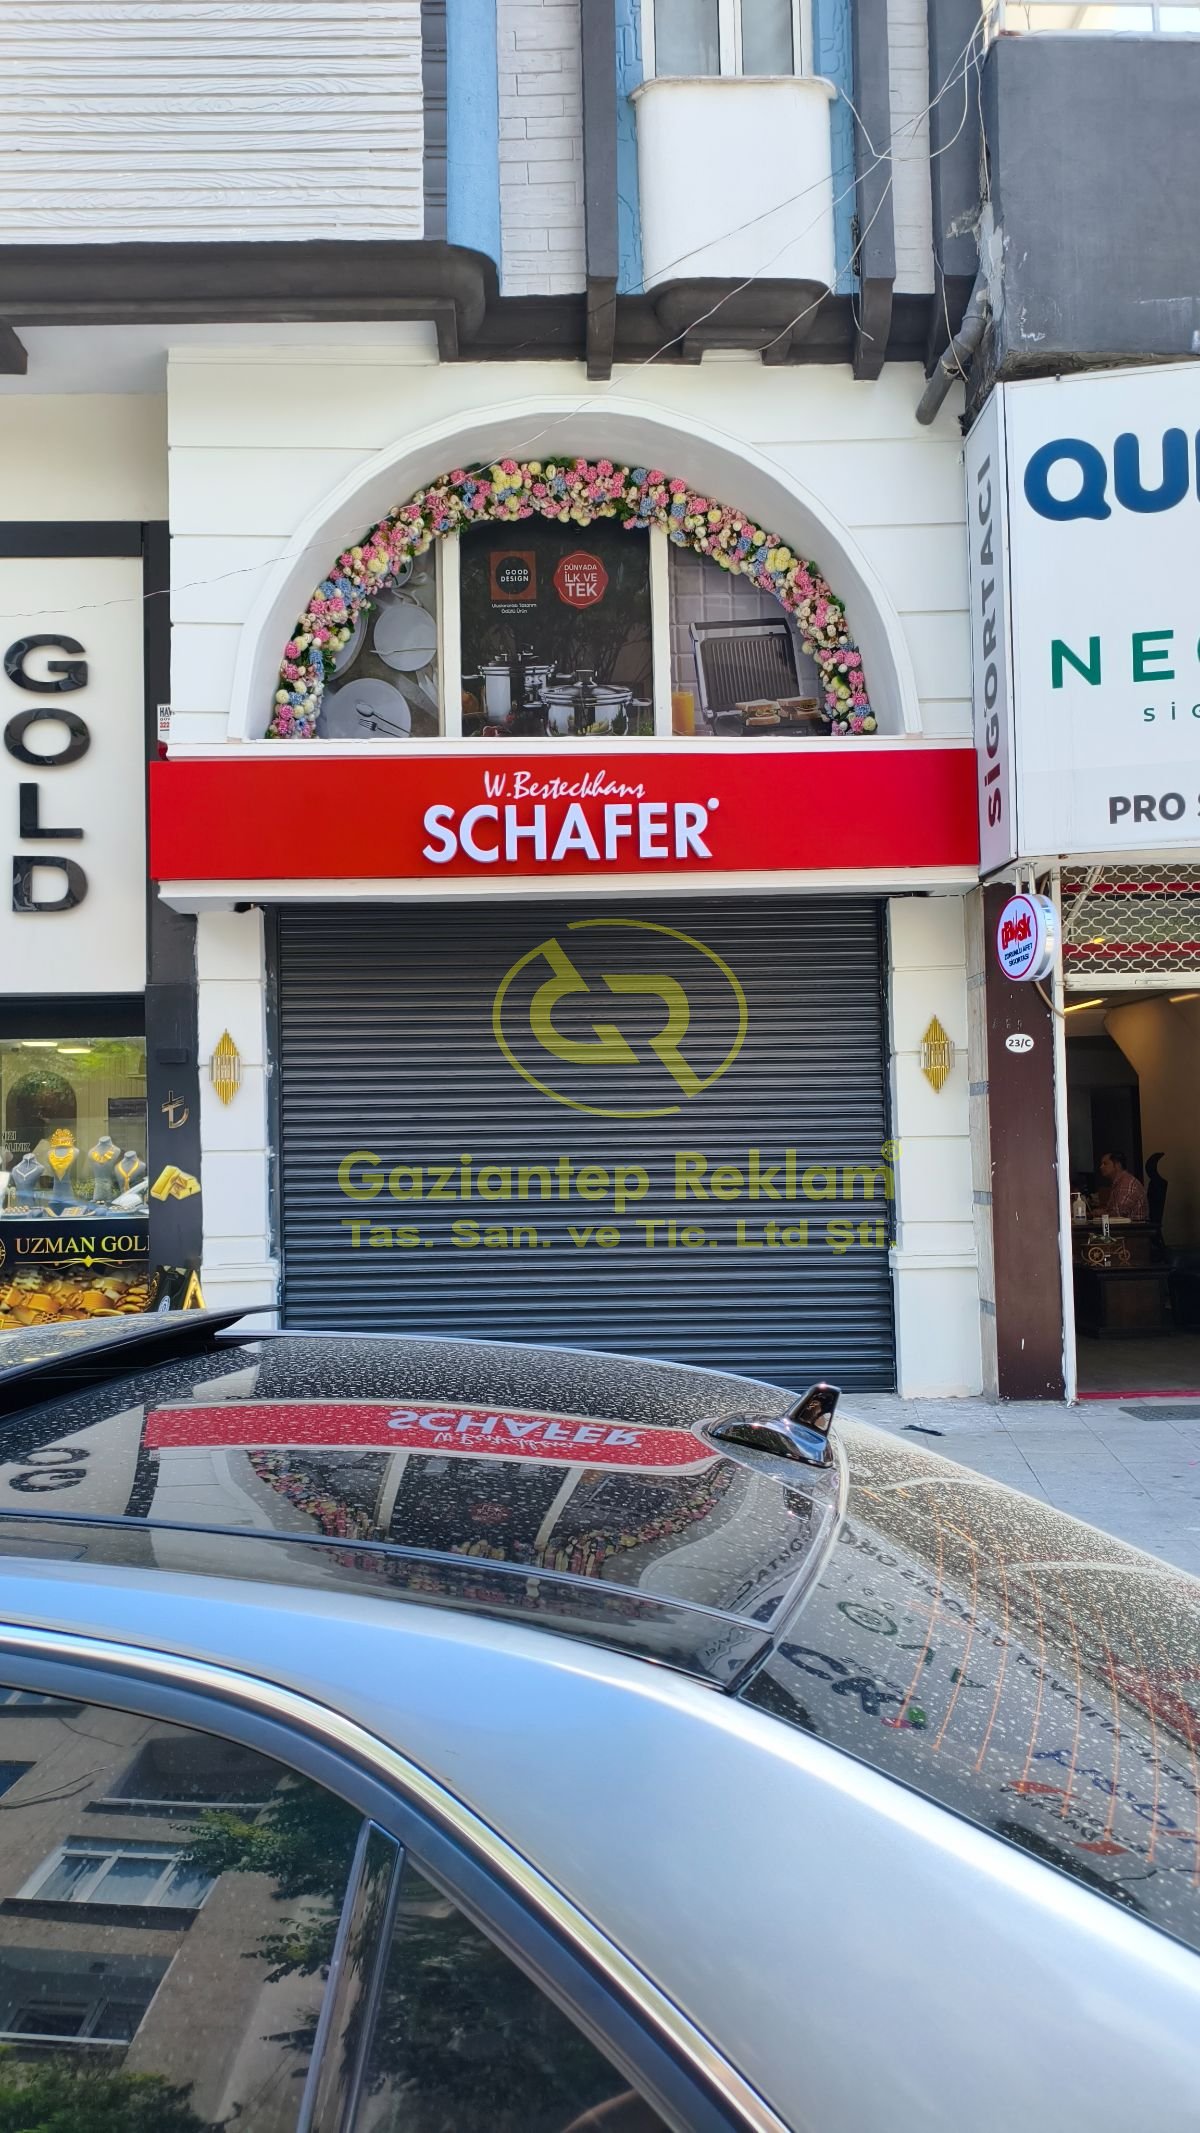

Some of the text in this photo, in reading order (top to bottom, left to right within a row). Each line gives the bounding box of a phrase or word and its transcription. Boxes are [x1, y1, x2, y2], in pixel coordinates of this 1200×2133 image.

[1024, 428, 1200, 521] QU
[564, 571, 598, 583] İLK VE
[565, 583, 598, 597] TEK
[1051, 629, 1200, 689] NE
[3, 634, 91, 913] GOLD
[1109, 792, 1186, 825] PRO
[422, 802, 714, 864] SCHAFER
[1008, 1038, 1032, 1049] 23/C
[15, 1235, 150, 1254] UZMAN GOL
